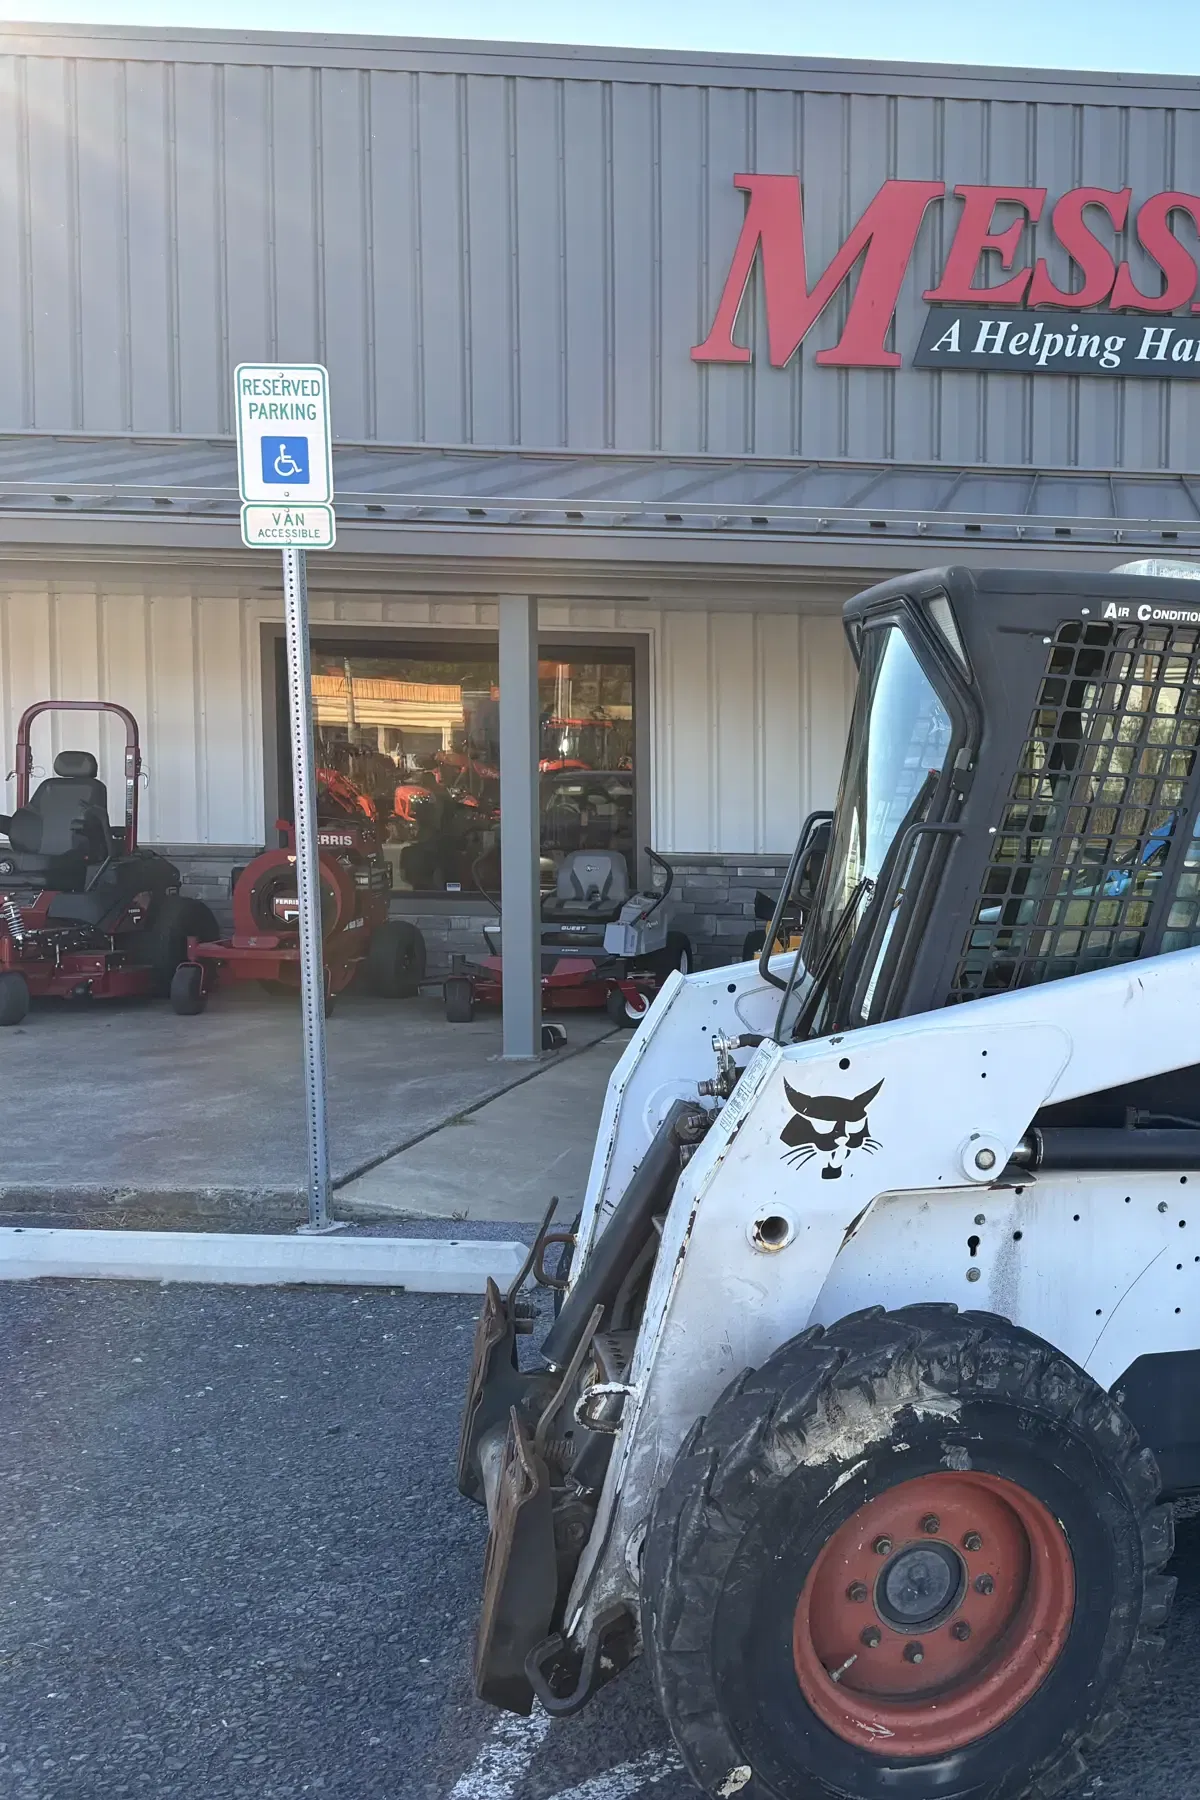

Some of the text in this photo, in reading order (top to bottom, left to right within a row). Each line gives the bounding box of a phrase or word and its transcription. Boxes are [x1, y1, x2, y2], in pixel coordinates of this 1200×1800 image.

[930, 318, 961, 352] A
[971, 320, 1126, 369] Helping
[242, 379, 320, 397] RESERVED
[248, 402, 317, 421] PARKING
[272, 513, 305, 526] VAN
[258, 528, 320, 538] ACCESSIBLE
[1103, 602, 1130, 619] AIR
